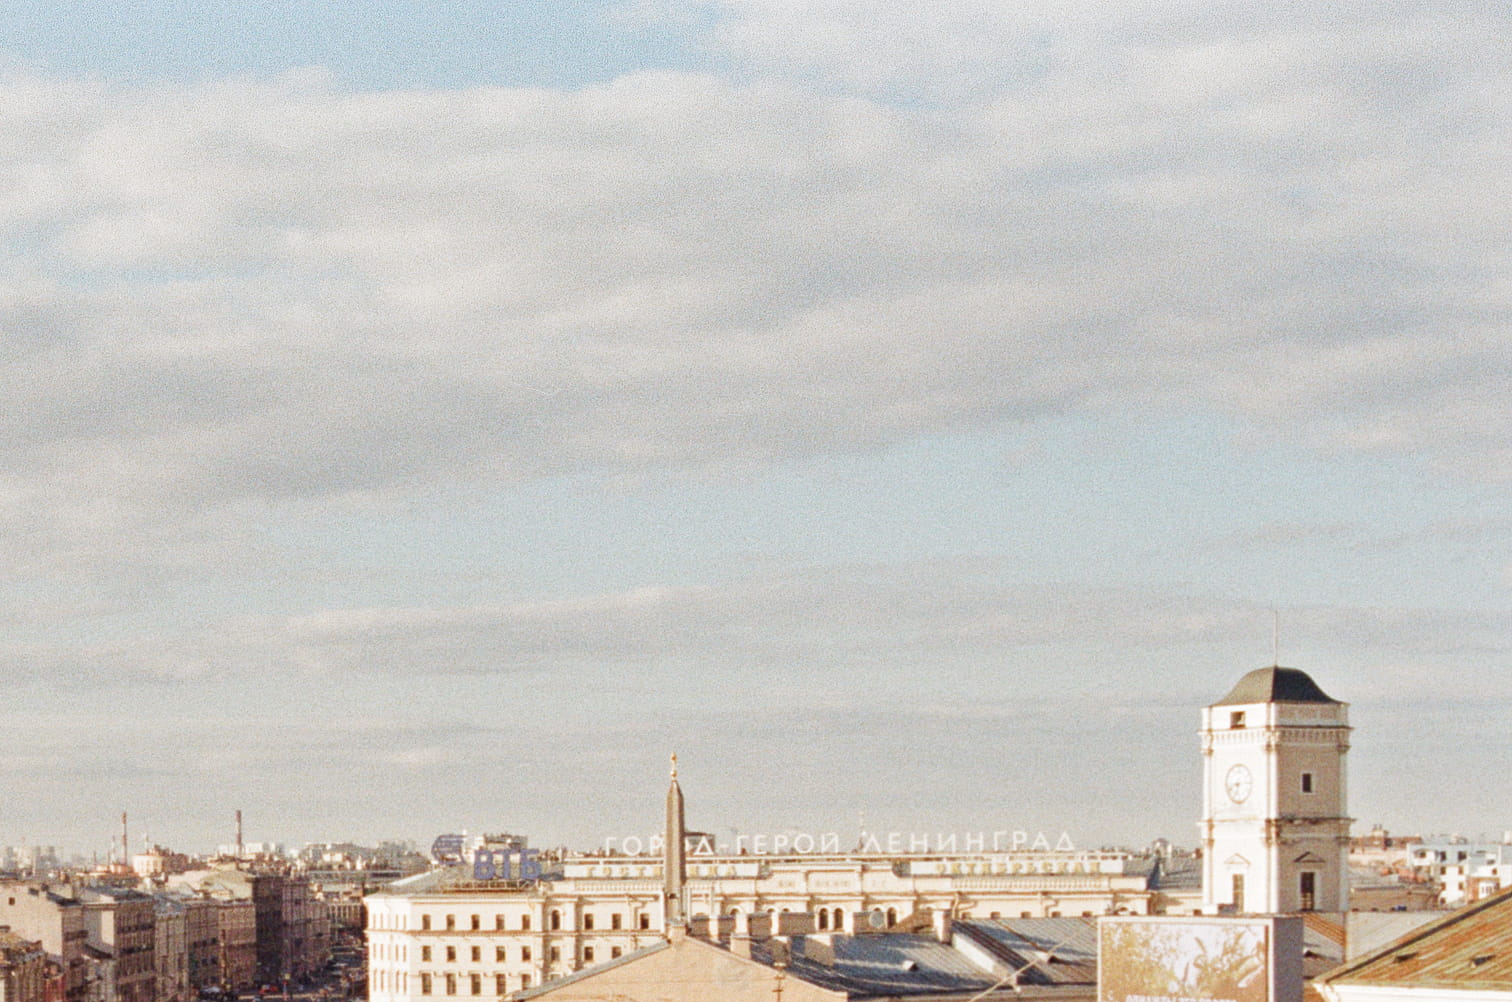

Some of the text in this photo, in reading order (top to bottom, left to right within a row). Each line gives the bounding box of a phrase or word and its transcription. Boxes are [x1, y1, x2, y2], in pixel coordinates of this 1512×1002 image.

[605, 830, 1076, 857] ГОРД-ГЕРОЙ ЛЕНИНГРАД
[474, 848, 541, 880] ВТБ
